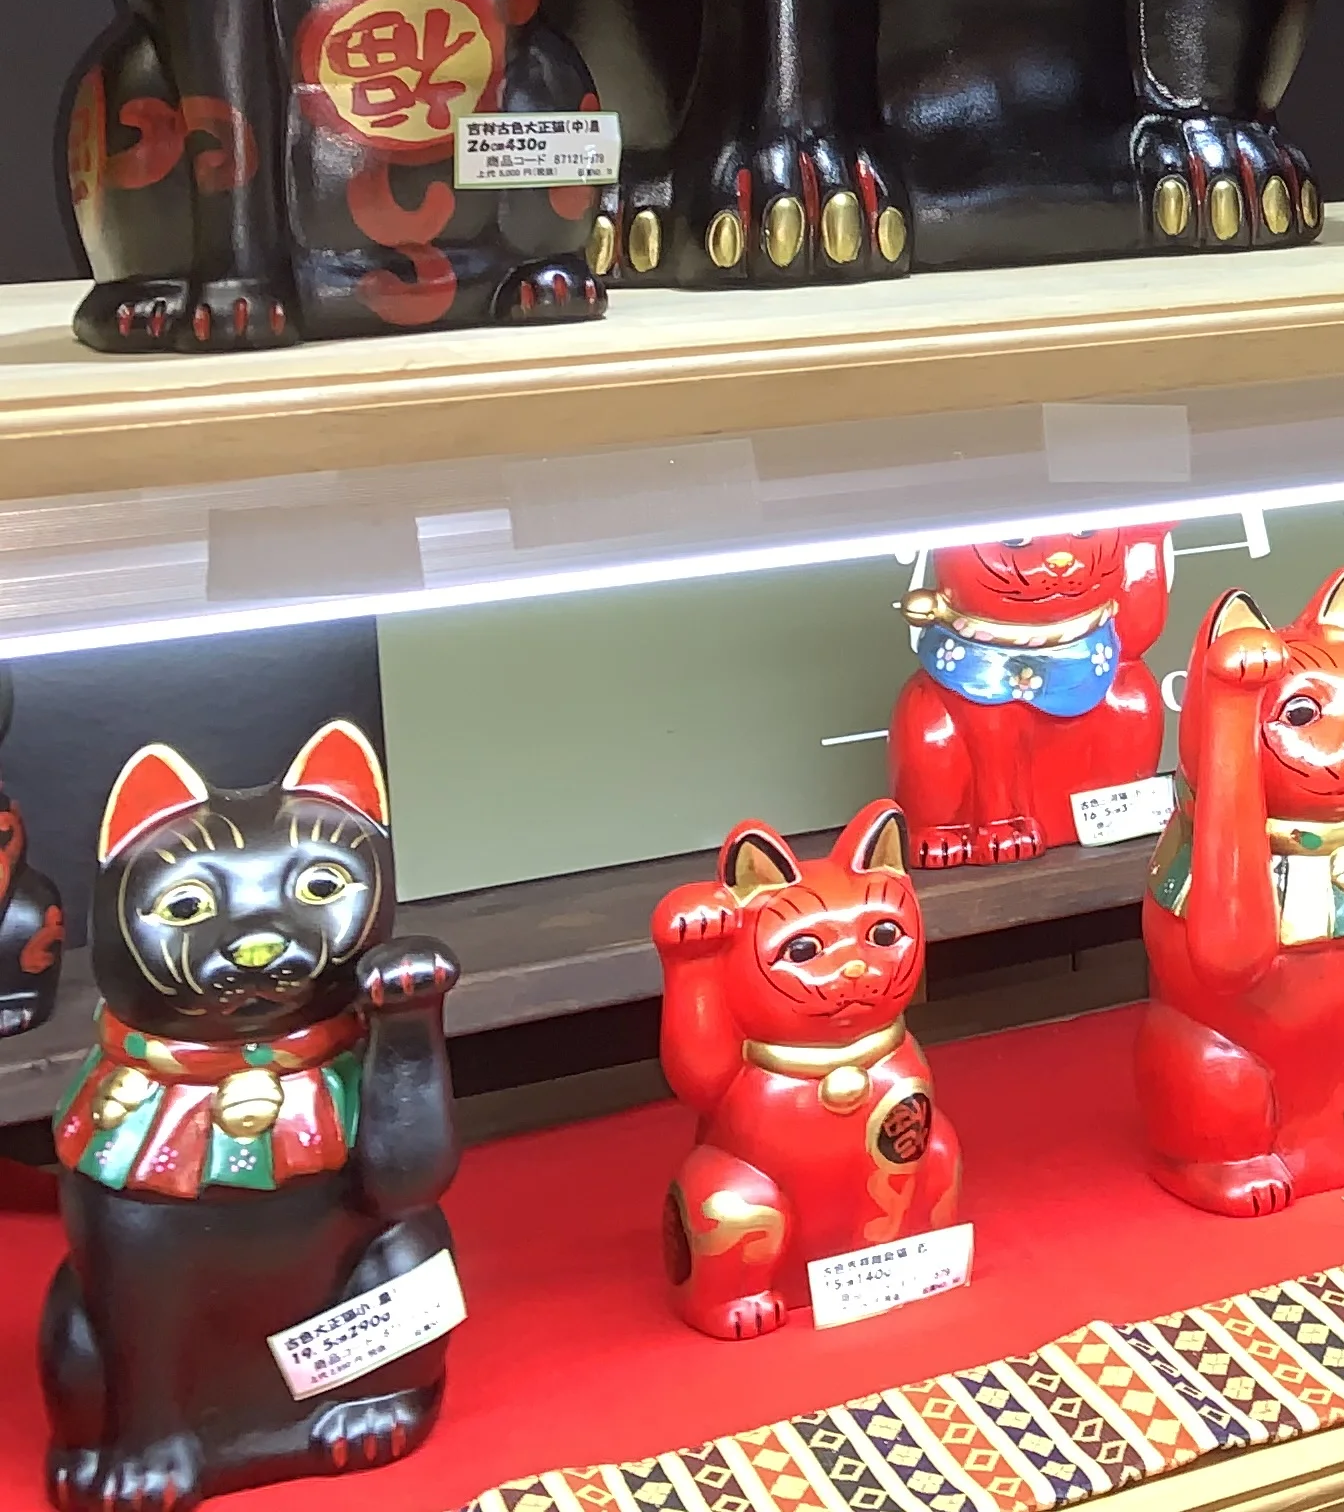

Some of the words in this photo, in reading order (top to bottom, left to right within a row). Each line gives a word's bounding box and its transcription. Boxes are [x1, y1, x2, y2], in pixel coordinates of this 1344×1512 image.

[486, 154, 547, 167] 商品コード
